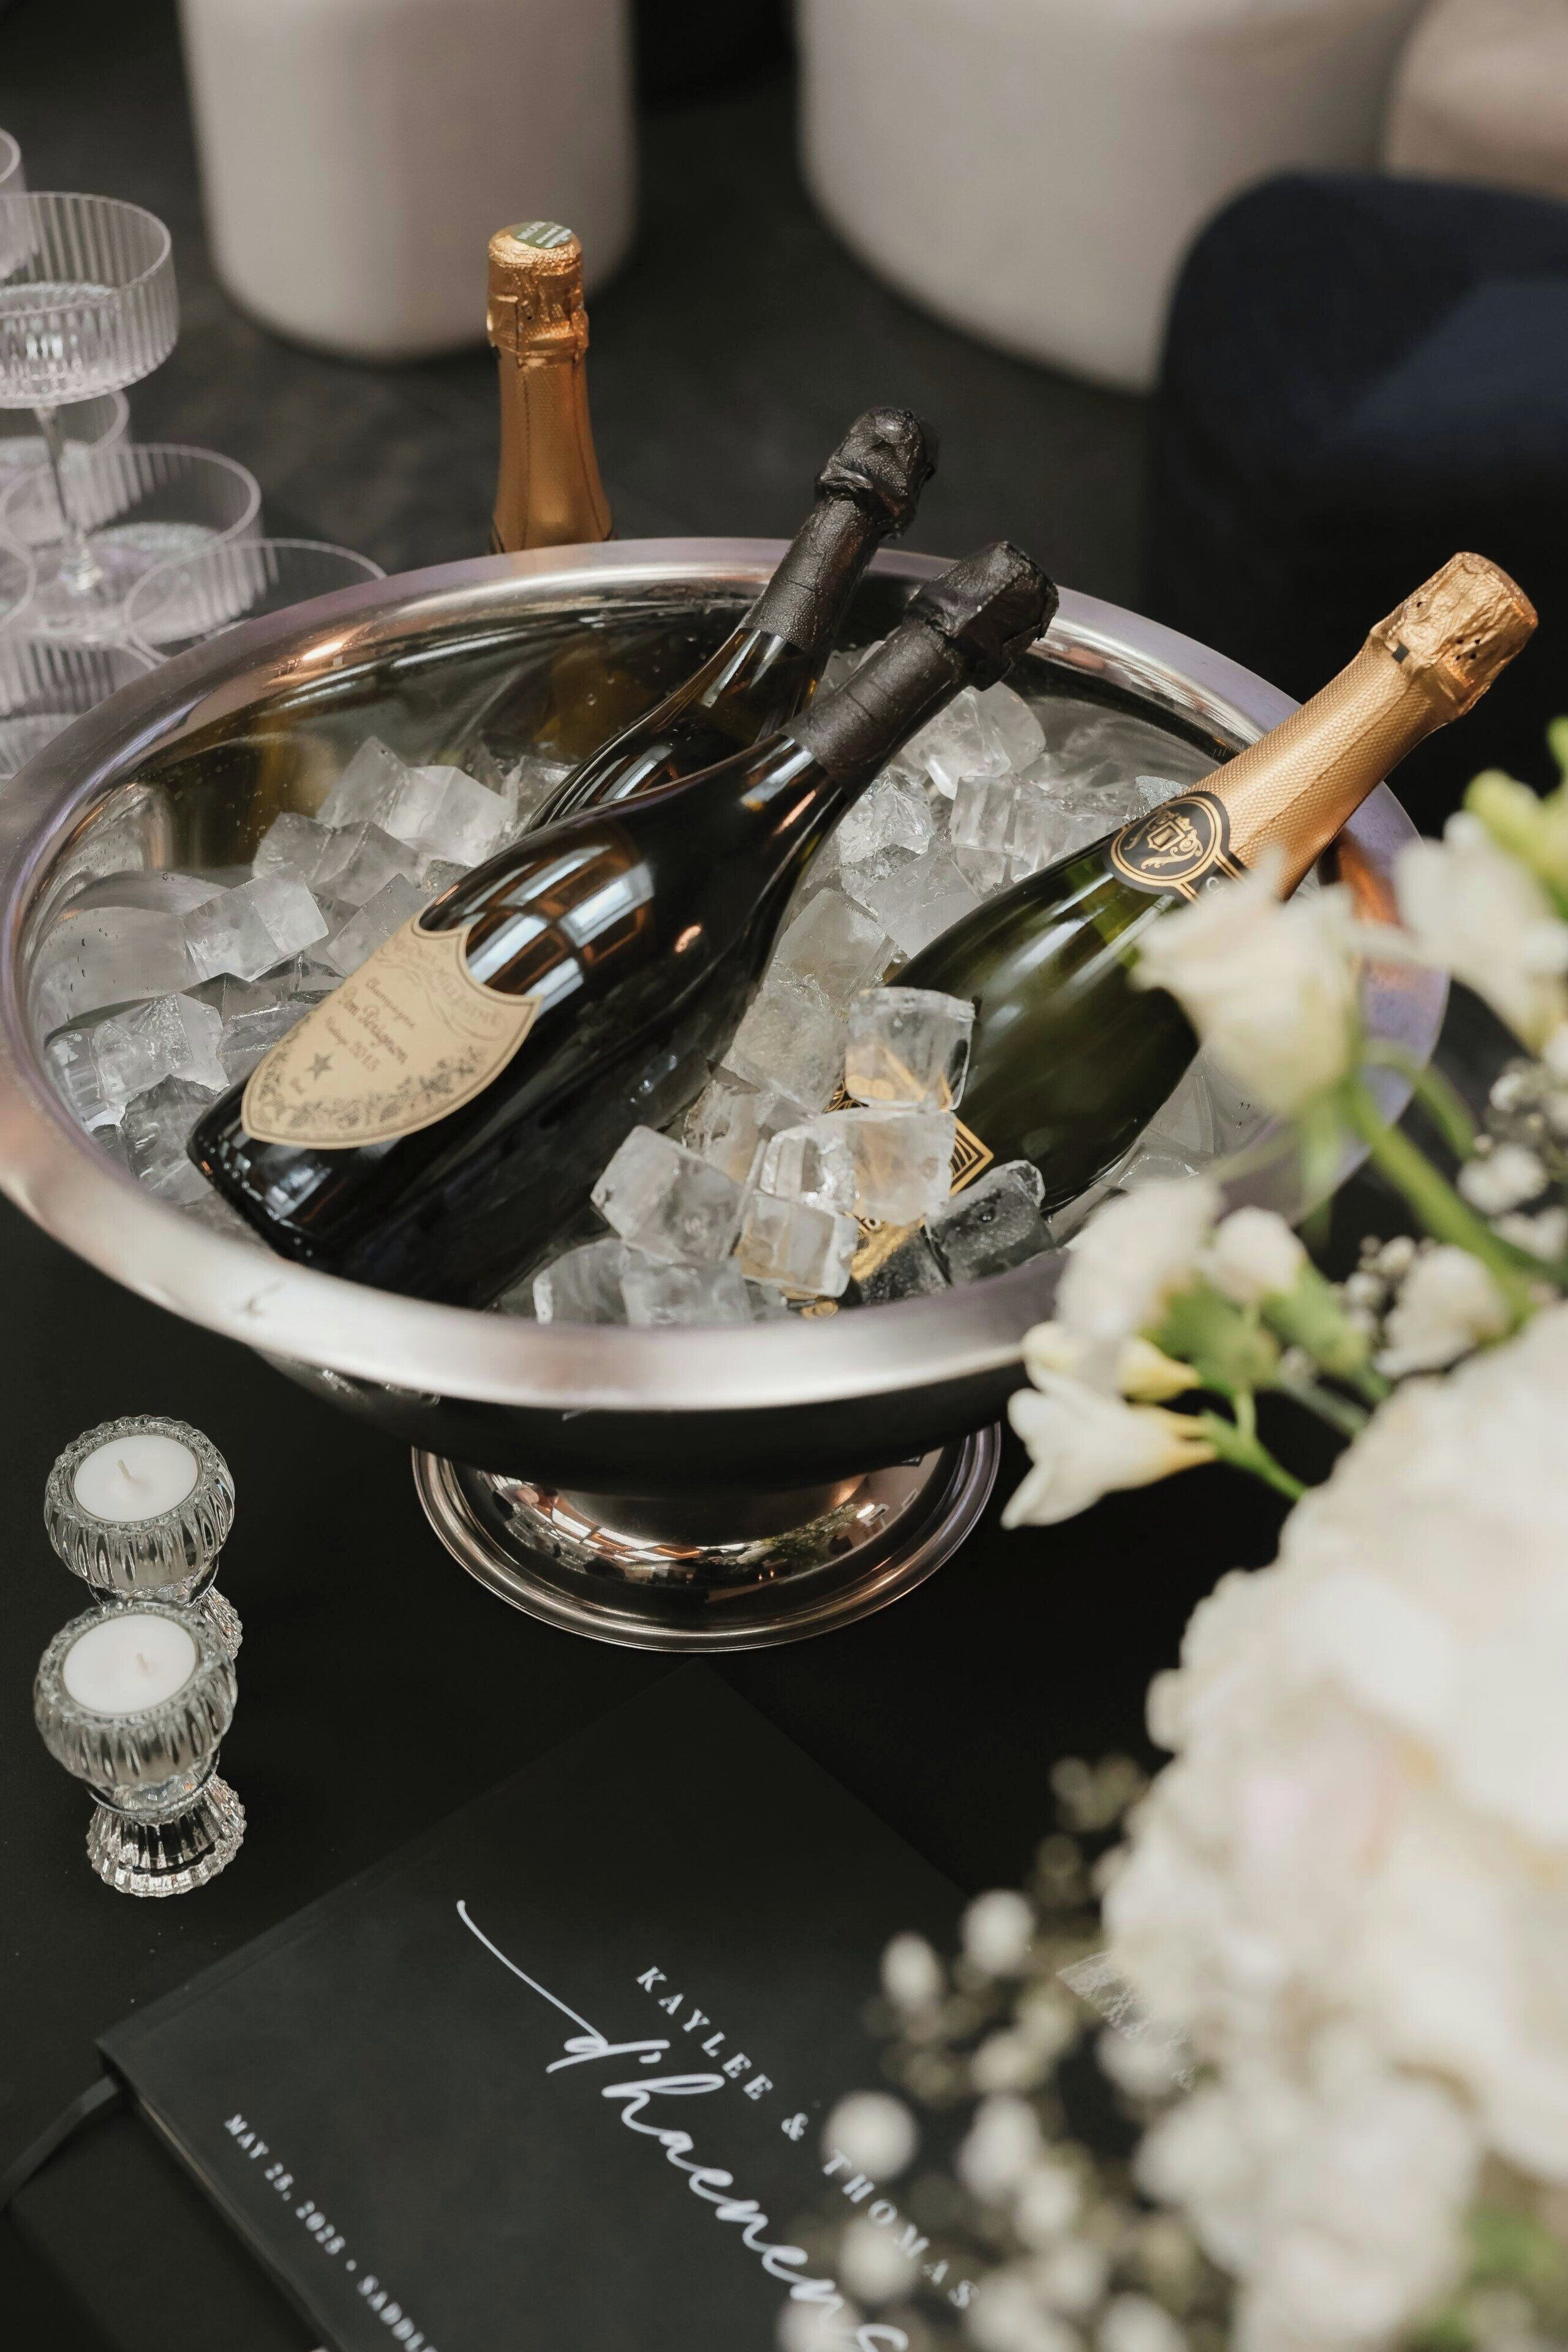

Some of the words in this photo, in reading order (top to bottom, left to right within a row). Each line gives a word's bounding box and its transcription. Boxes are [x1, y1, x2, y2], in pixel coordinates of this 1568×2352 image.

[224, 2113, 270, 2160] MAY
[356, 2274, 443, 2352] SADDL
[636, 1966, 774, 2101] KAYLEE
[781, 2112, 809, 2141] &
[823, 2149, 978, 2309] THOMAS
